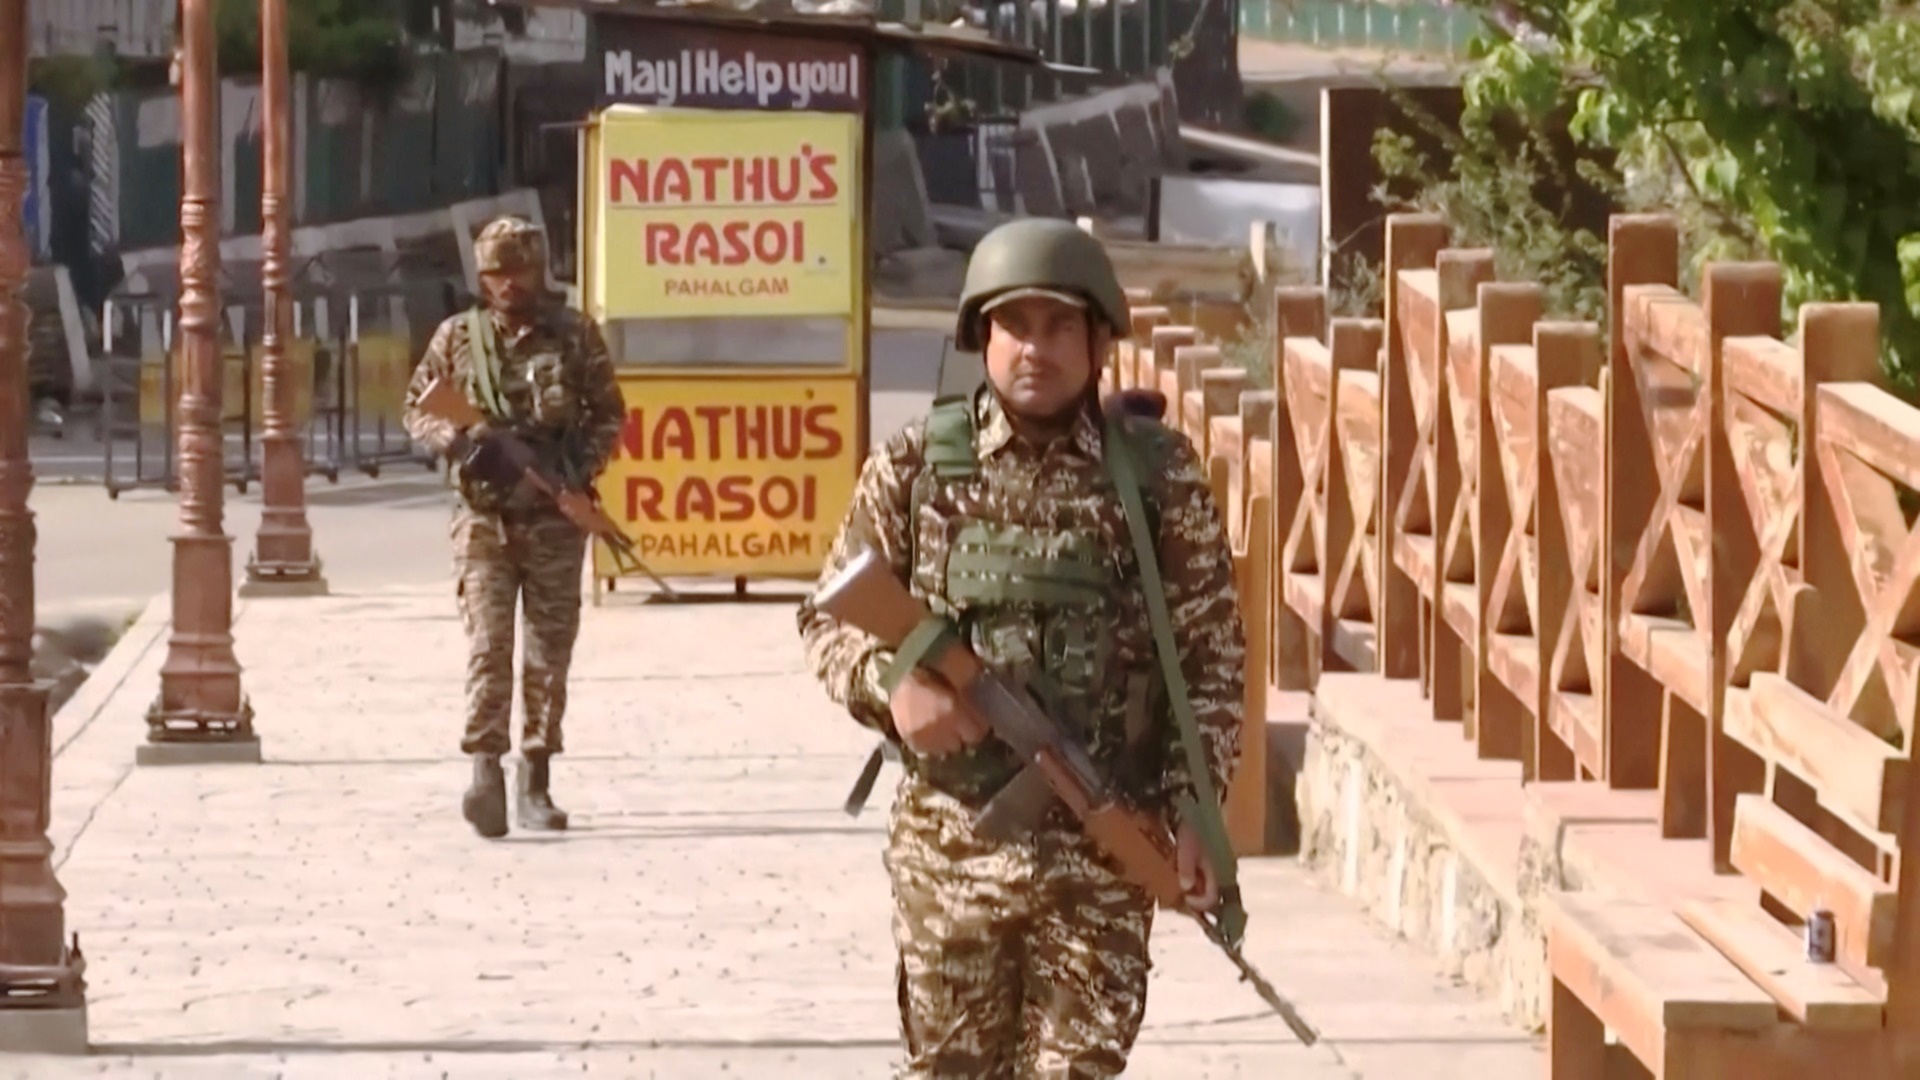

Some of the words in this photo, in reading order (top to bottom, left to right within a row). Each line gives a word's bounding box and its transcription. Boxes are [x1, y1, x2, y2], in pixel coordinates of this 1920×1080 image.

[605, 50, 677, 106] May
[695, 50, 783, 106] Help
[610, 143, 838, 202] NATHU'S
[645, 220, 804, 265] RASOI
[664, 277, 789, 296] PAHALGAM
[625, 474, 816, 522] RASOI
[640, 531, 811, 558] PAHALGAM
